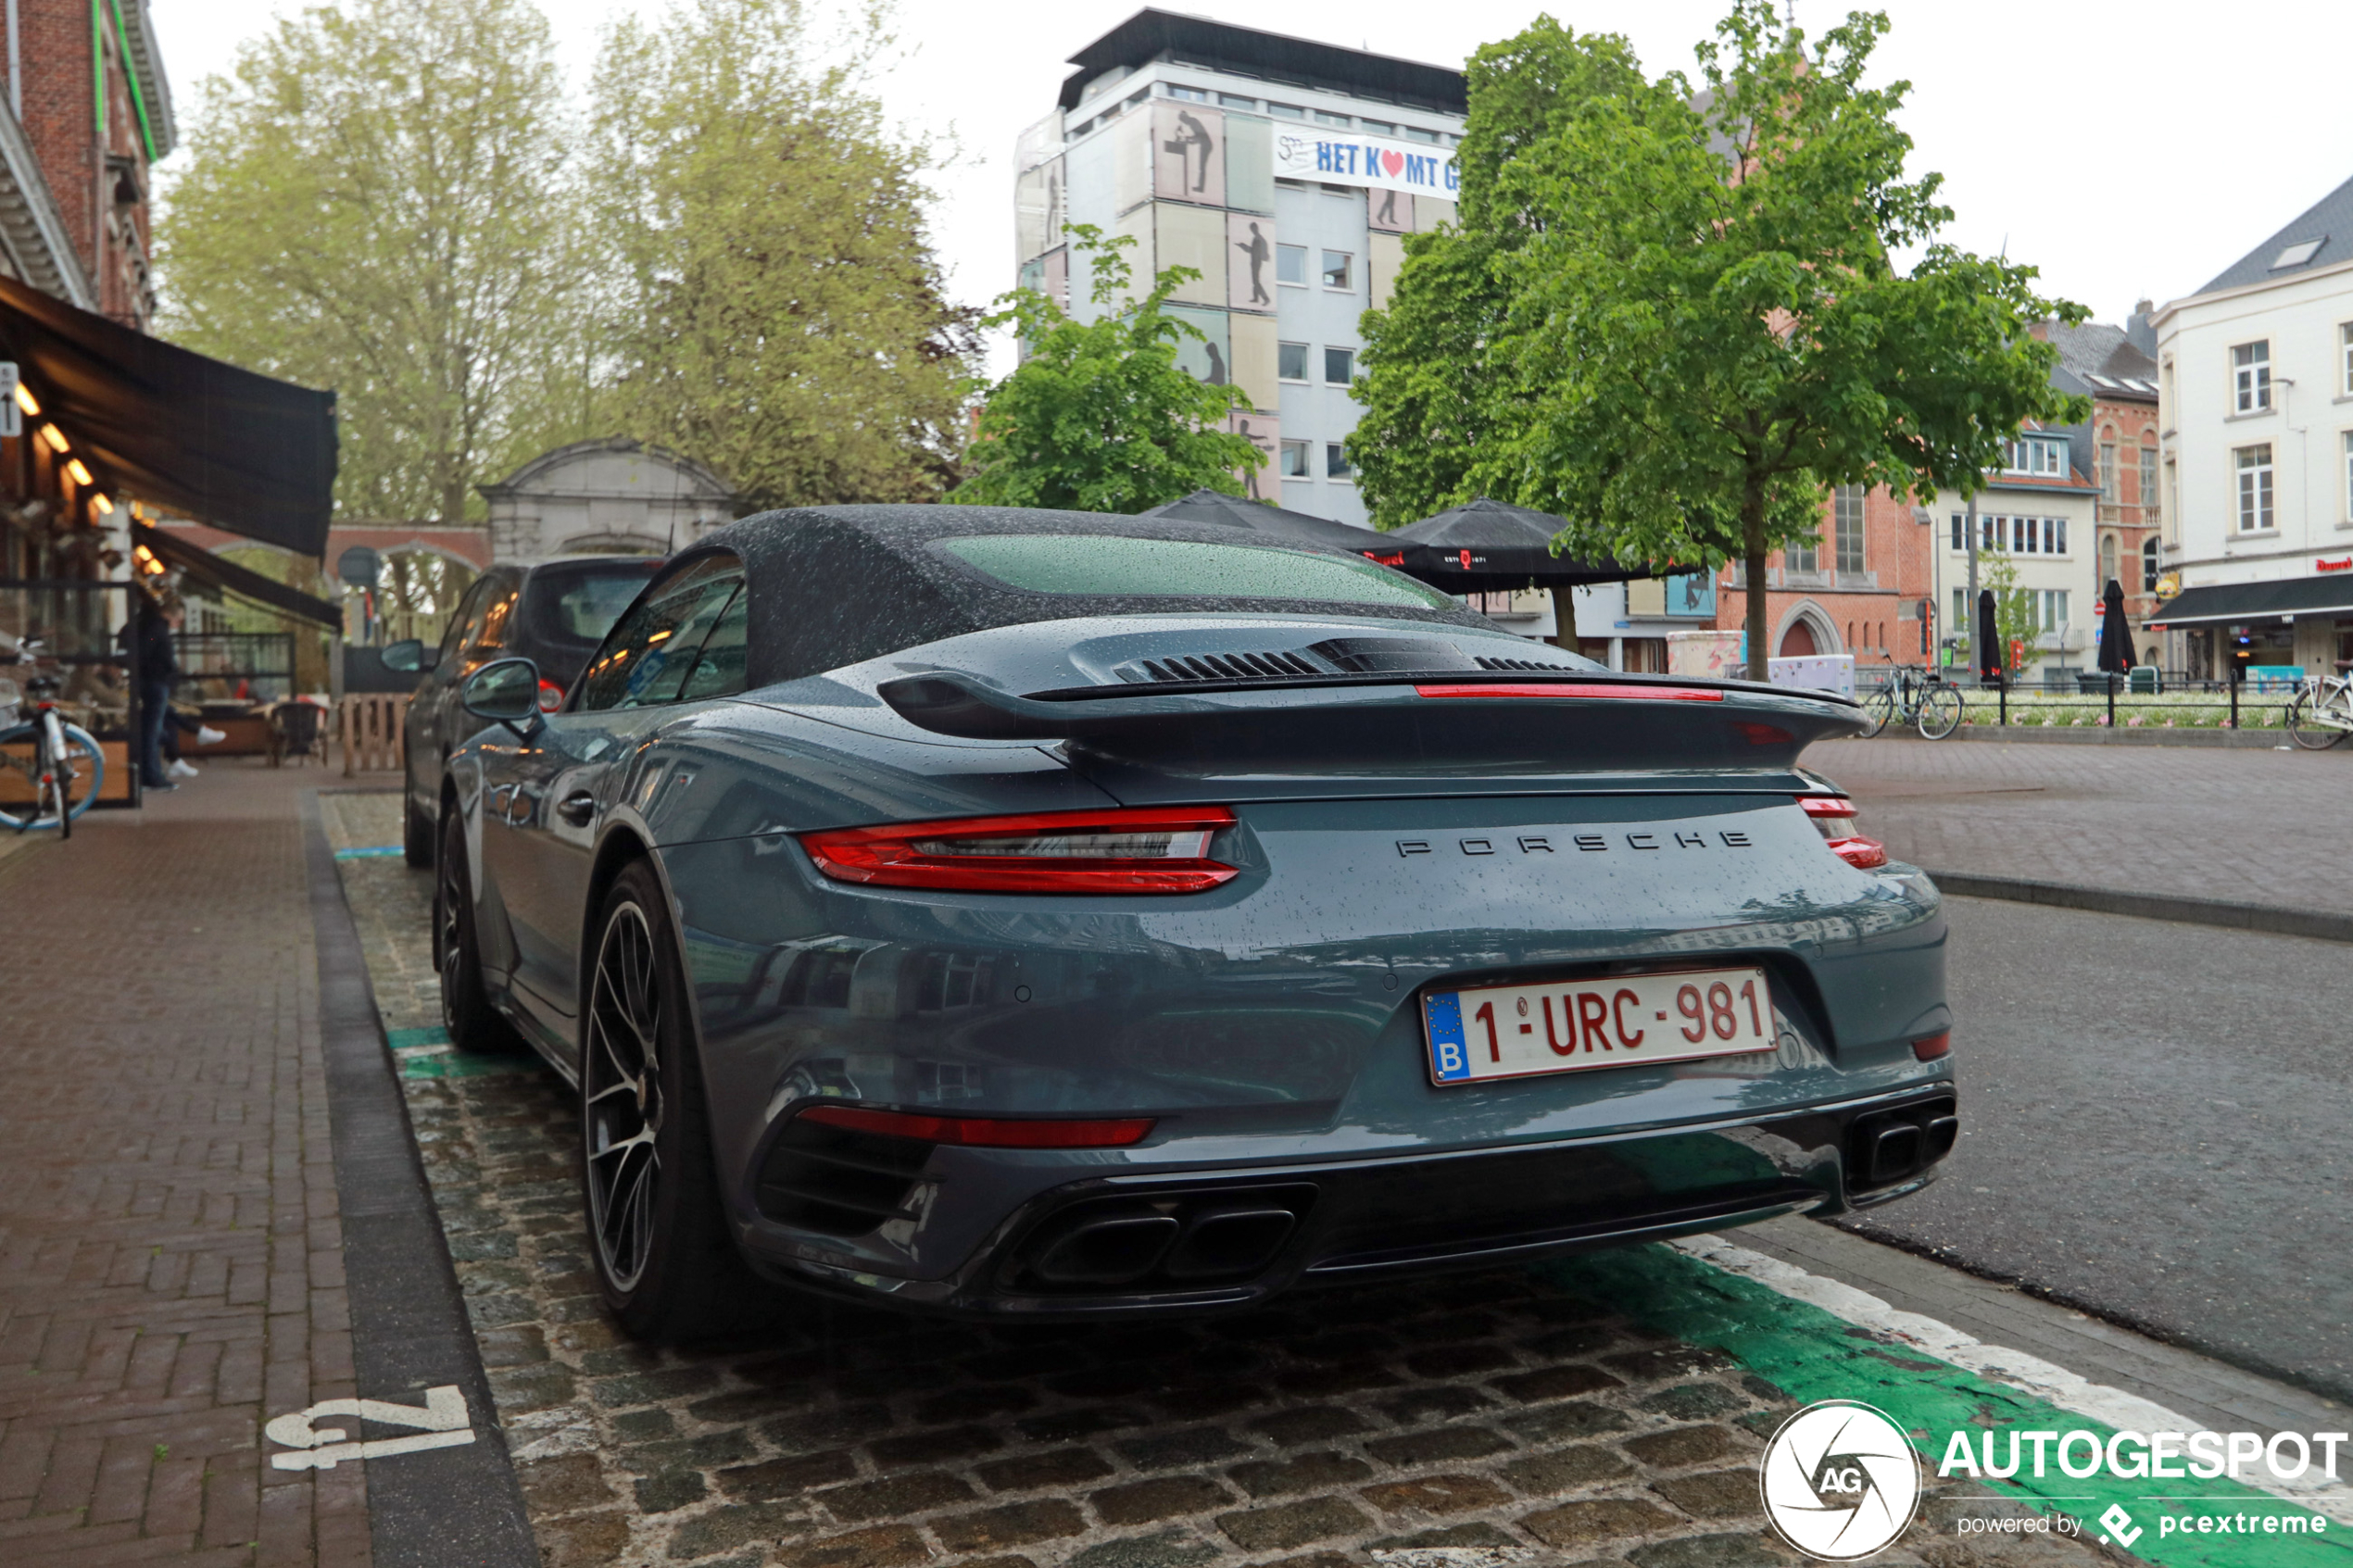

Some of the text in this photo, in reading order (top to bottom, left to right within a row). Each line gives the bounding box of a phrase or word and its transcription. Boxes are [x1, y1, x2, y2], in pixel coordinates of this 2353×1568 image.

[1316, 142, 1359, 175] HET
[1396, 831, 1752, 858] PORSCHE
[1439, 1043, 1462, 1073] B
